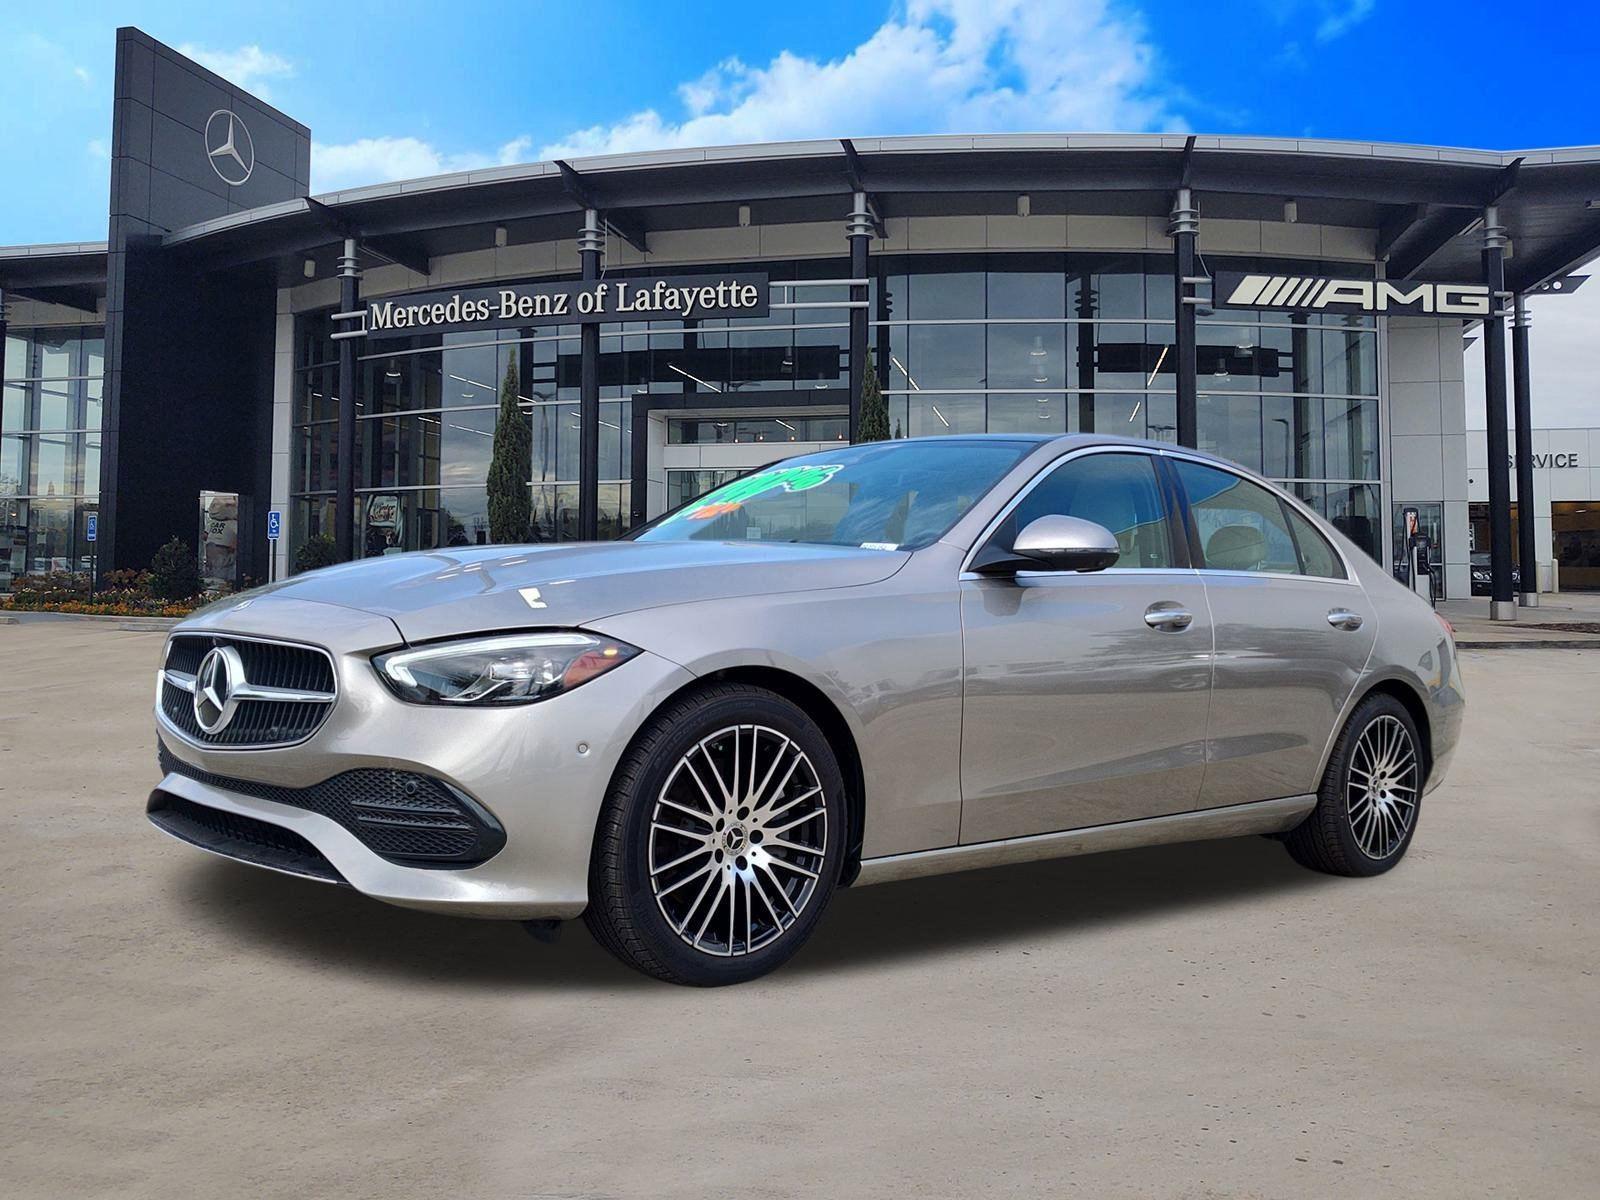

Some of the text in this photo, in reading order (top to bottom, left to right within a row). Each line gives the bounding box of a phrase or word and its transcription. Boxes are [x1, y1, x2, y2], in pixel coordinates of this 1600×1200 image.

[370, 279, 758, 331] Mercedes-Benz of Lafayette
[1312, 279, 1490, 315] AMG
[1507, 453, 1578, 468] SRVICE
